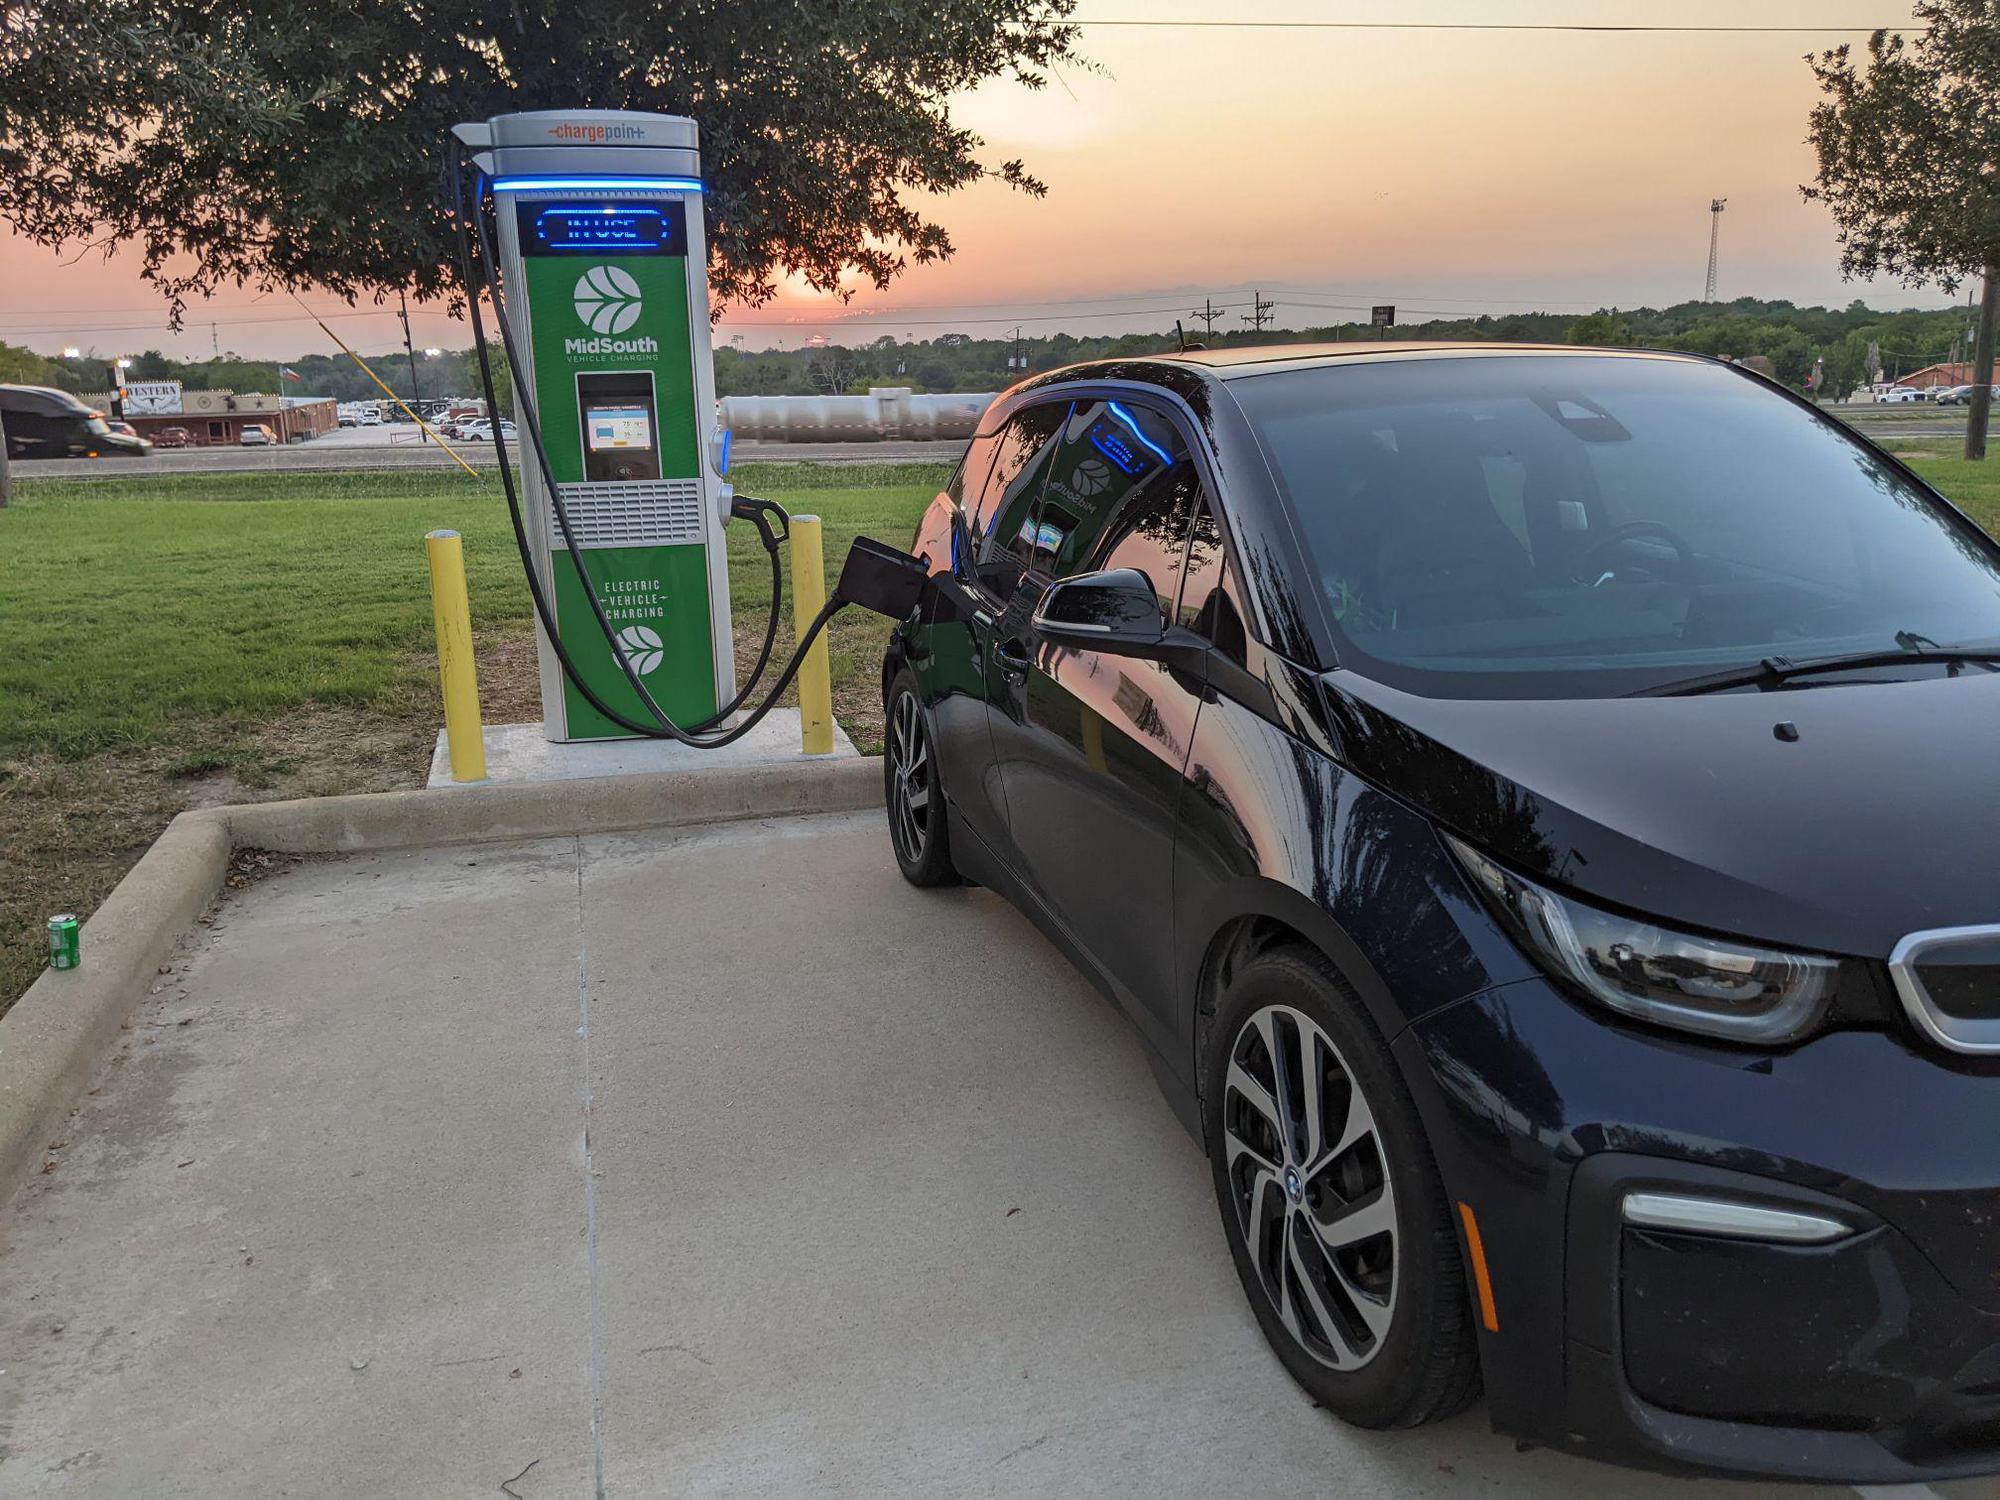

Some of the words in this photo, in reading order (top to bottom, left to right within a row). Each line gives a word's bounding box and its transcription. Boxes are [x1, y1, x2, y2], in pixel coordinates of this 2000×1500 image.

[549, 123, 645, 141] chargepoint
[564, 336, 659, 354] MidSouth
[566, 355, 607, 363] VEHICLE
[610, 354, 659, 362] CHARGING
[604, 580, 660, 592] ELECTRIC
[609, 594, 658, 606] VEHICLE
[605, 607, 664, 620] CHARGING
